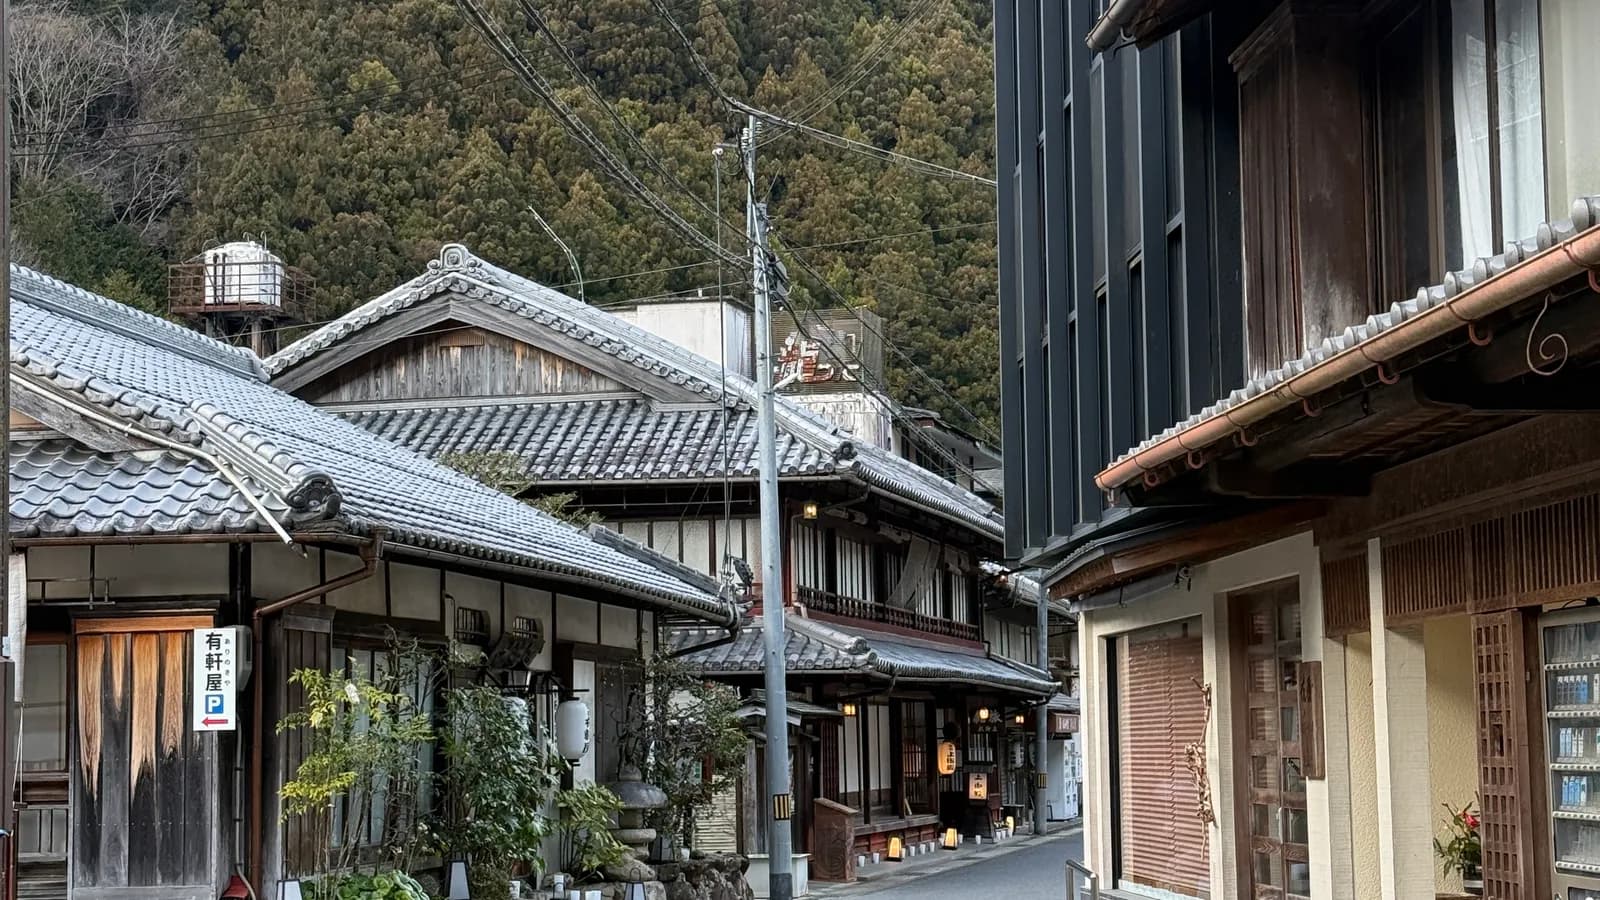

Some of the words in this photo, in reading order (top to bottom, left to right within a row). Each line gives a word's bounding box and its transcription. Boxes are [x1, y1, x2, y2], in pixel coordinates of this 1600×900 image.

[205, 632, 223, 691] 有軒屋
[207, 695, 222, 713] P
